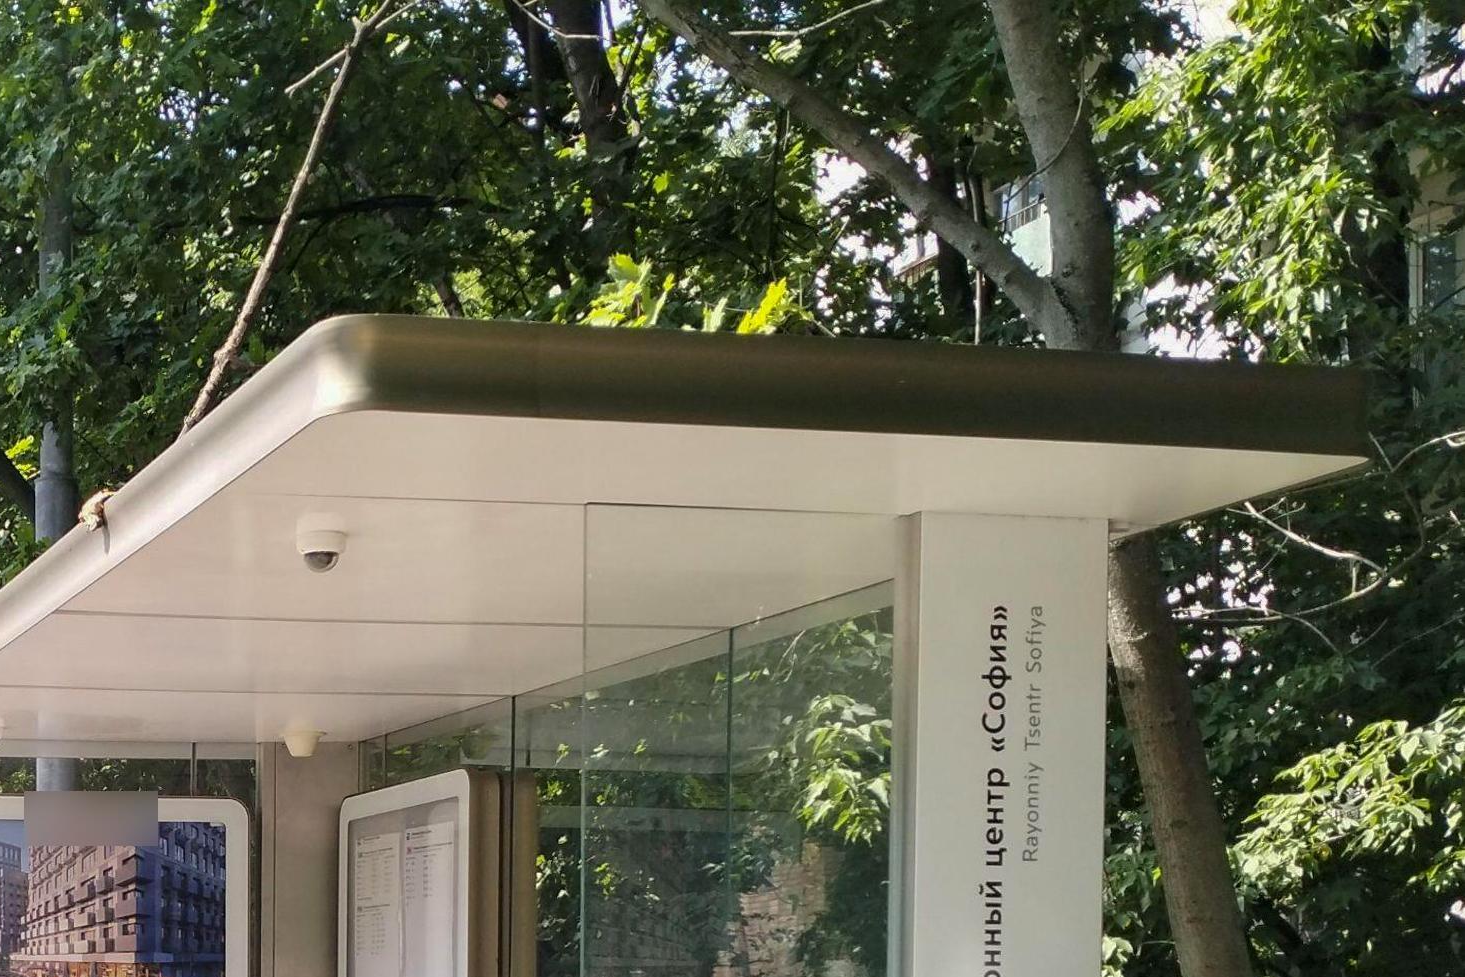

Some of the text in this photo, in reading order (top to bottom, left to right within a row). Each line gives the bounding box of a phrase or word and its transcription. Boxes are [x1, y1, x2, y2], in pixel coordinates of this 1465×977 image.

[981, 605, 1013, 752] «София»
[1022, 605, 1047, 862] Rayonniy Tsentr Sofiya
[985, 767, 1011, 866] центр
